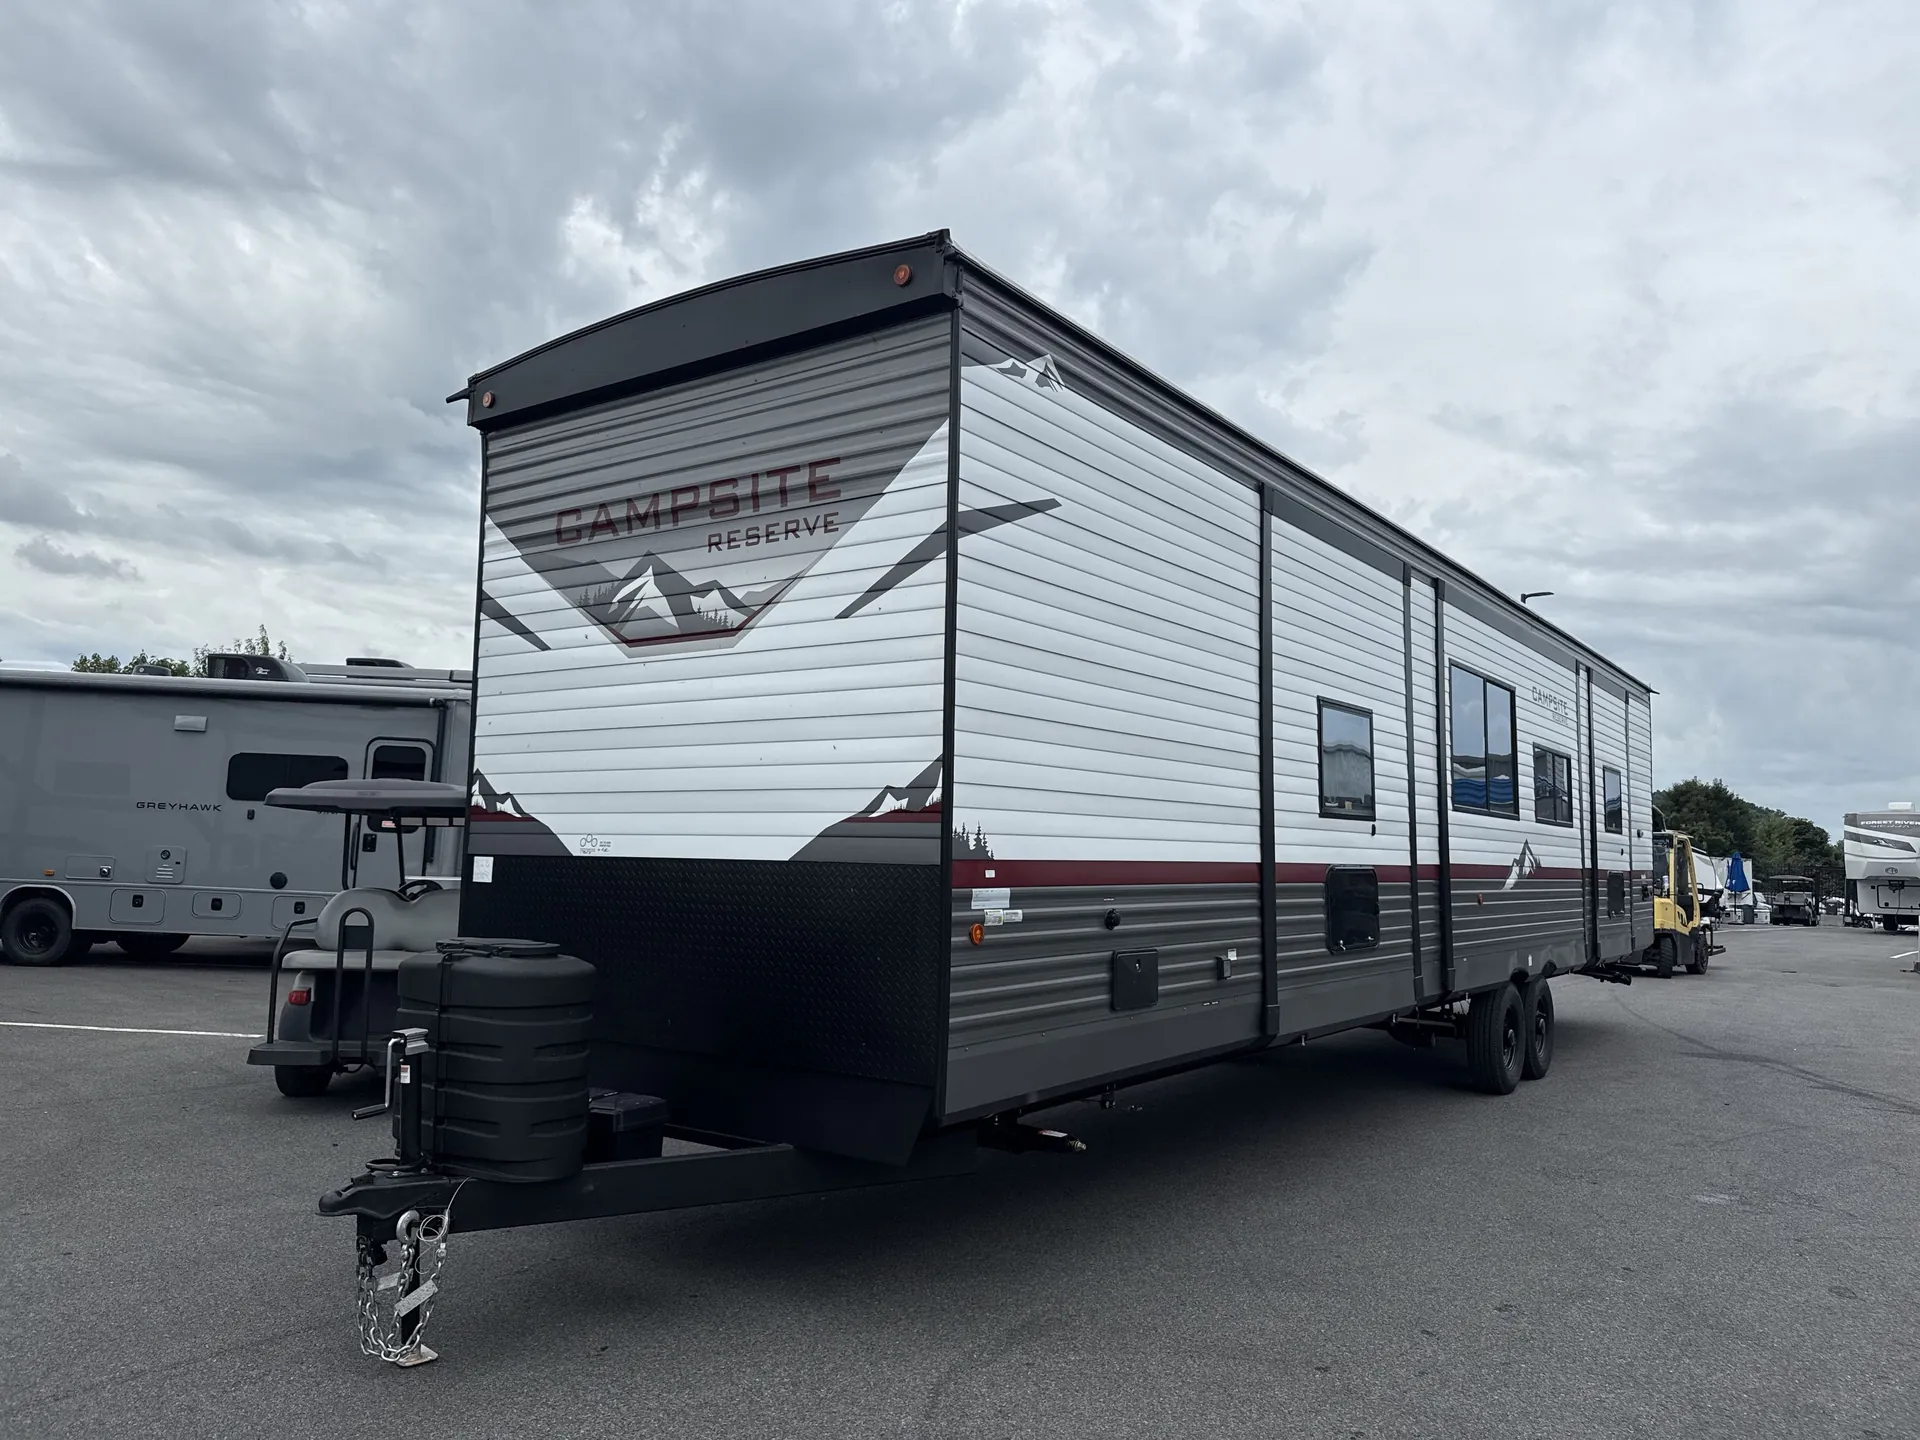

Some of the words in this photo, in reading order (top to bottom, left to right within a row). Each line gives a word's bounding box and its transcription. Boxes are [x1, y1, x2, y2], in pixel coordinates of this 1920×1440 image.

[555, 457, 841, 546] CAMPSITE
[707, 512, 839, 552] RESERVE
[1532, 686, 1569, 715] CAMPSITE
[136, 802, 222, 811] GREYHAWK
